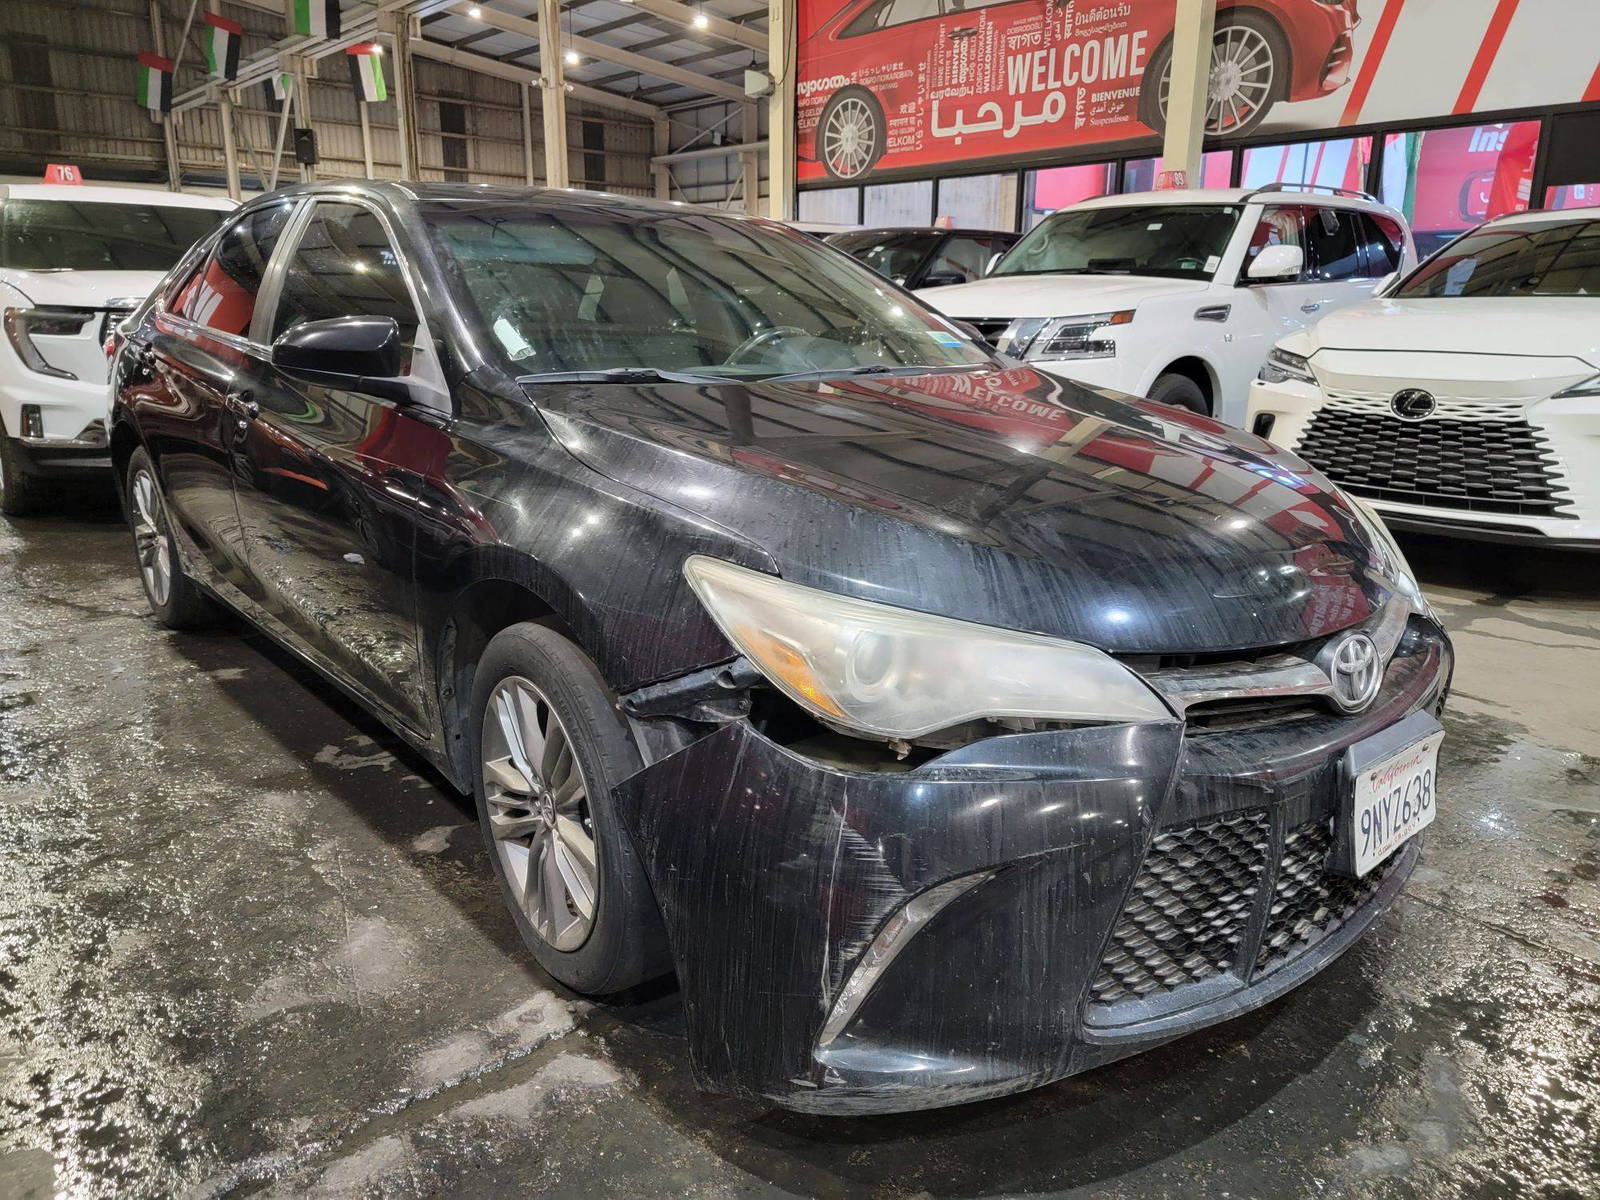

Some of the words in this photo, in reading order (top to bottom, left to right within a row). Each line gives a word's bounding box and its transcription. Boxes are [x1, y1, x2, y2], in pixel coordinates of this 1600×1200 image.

[1075, 2, 1131, 26] ยินดีต้อนรับ
[983, 21, 993, 93] WILLKOMMEN
[997, 34, 1006, 90] Suspendisse
[1007, 30, 1148, 96] WELCOME
[975, 63, 983, 94] ДОБРО
[1091, 86, 1141, 103] BIENVENUE
[931, 91, 1066, 145] مرحبا
[887, 134, 915, 148] ELKOM
[56, 166, 74, 181] 76
[1361, 768, 1431, 857] 9NYZ638
